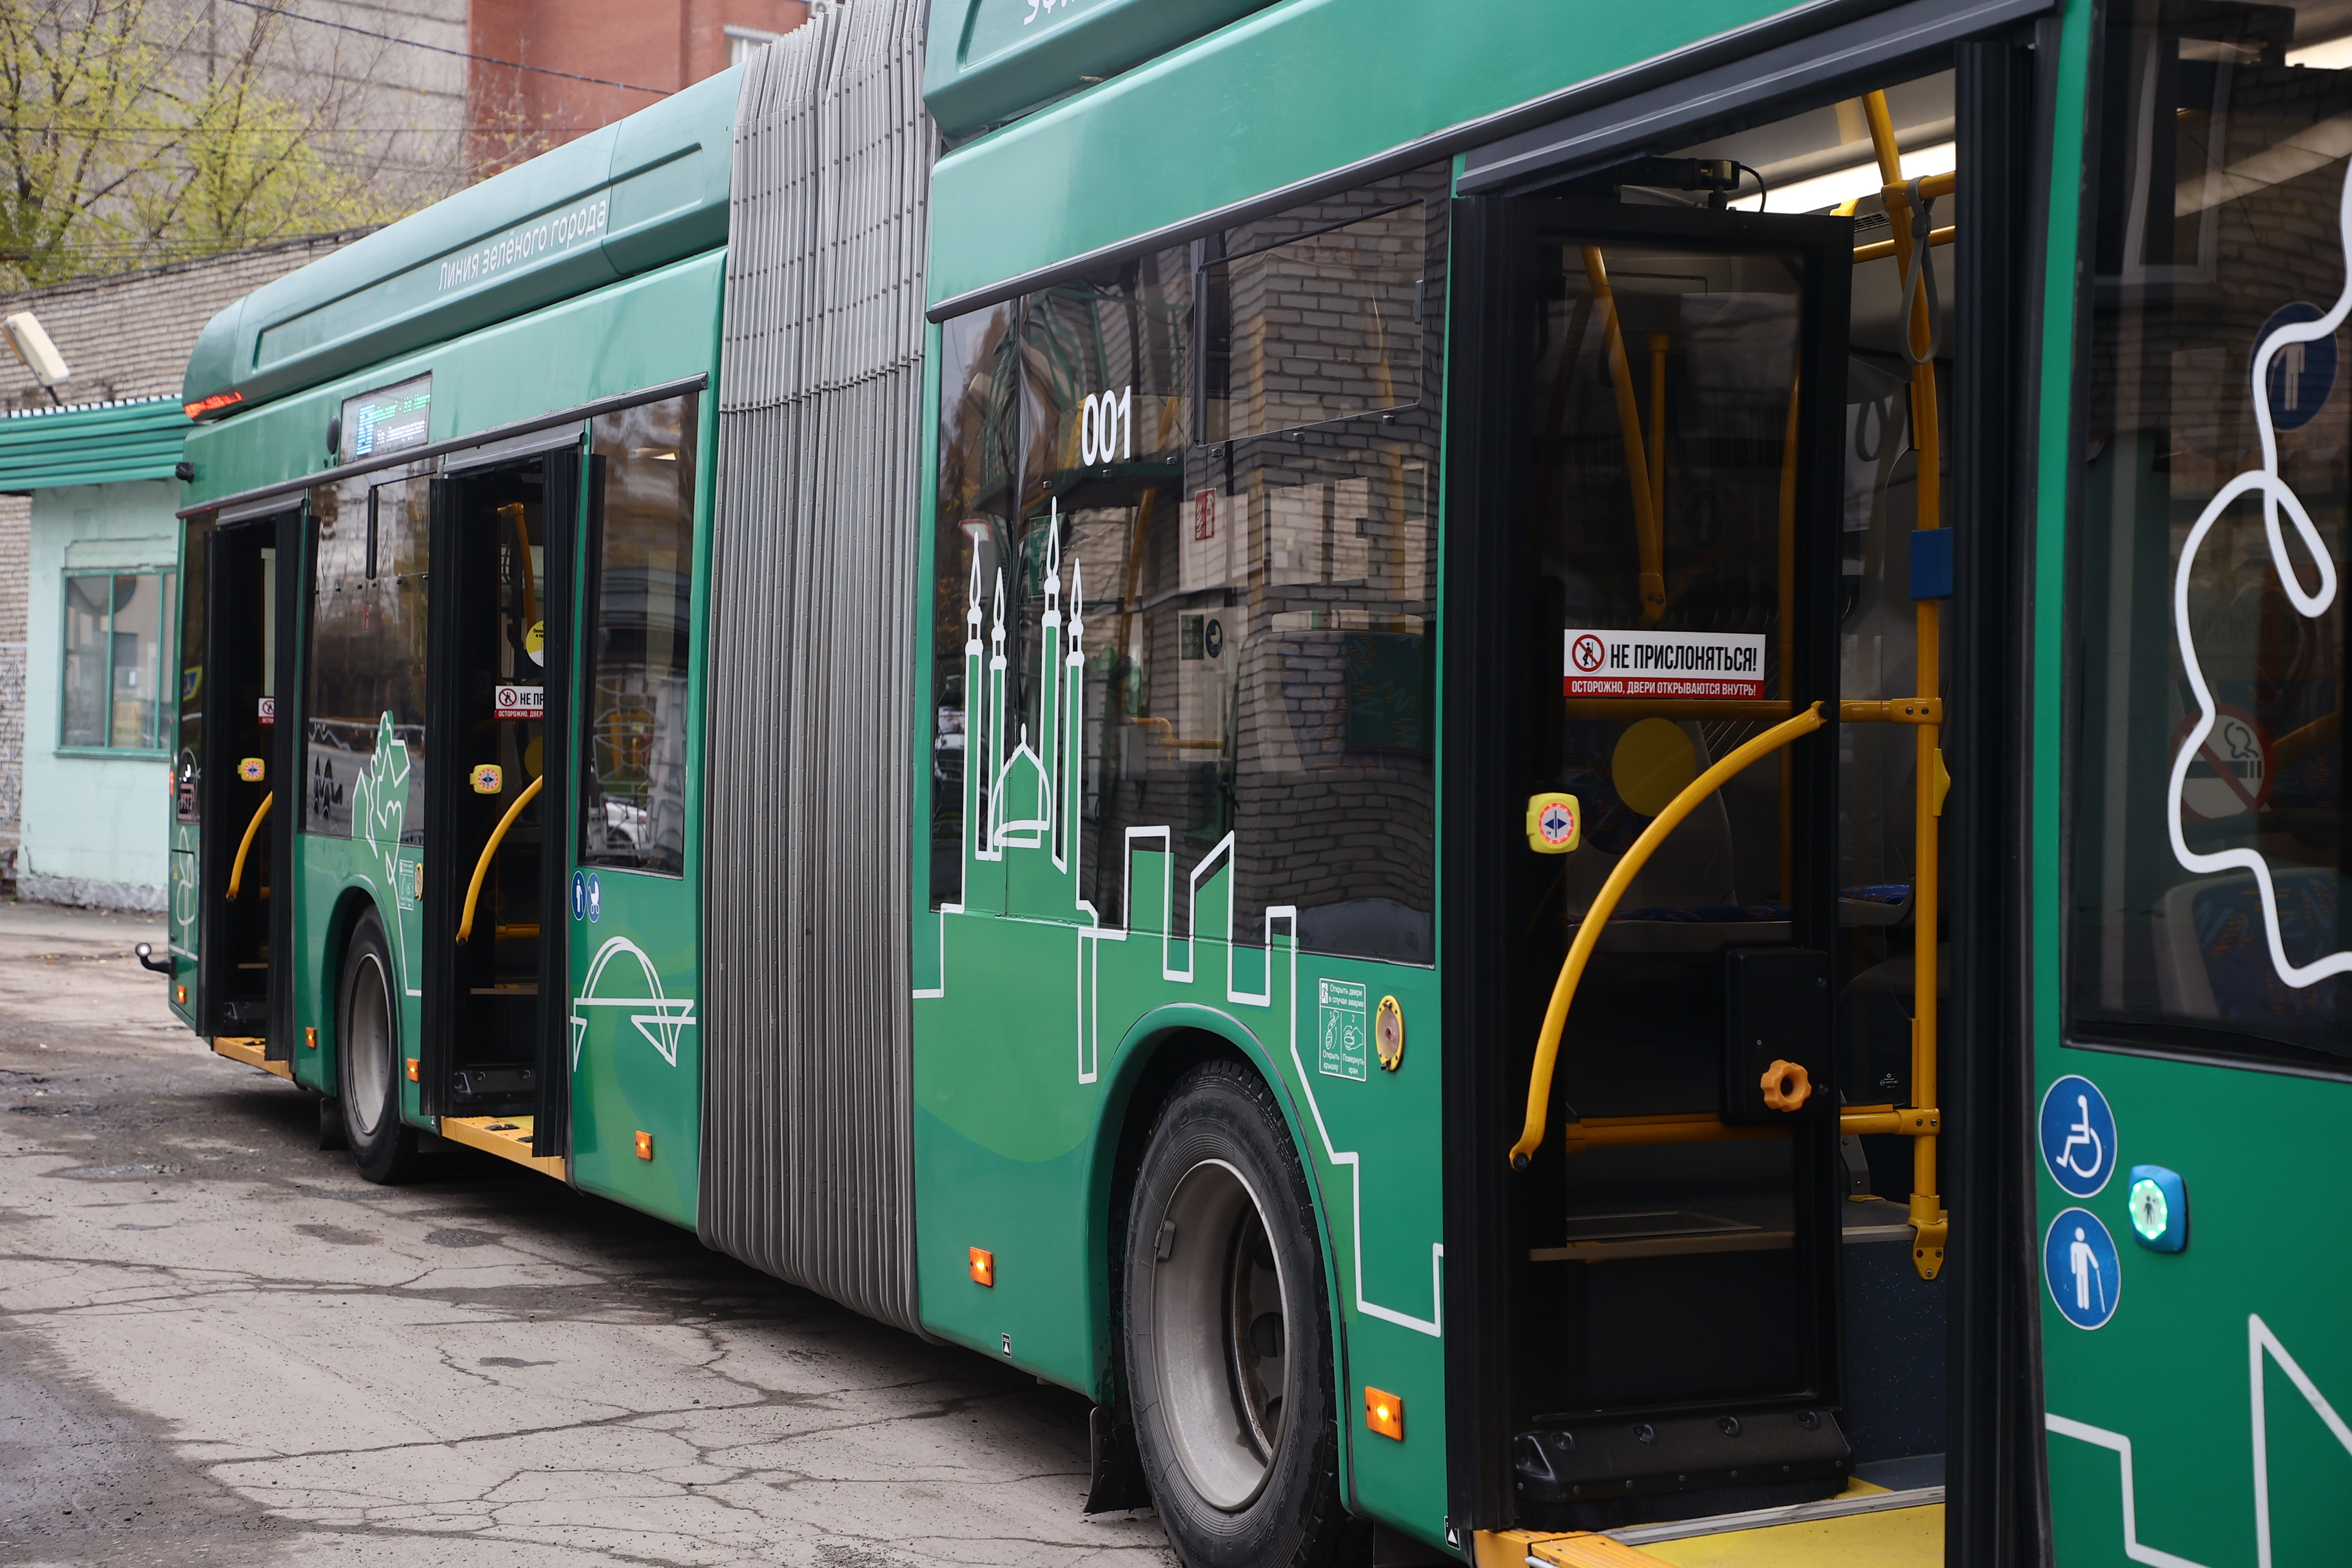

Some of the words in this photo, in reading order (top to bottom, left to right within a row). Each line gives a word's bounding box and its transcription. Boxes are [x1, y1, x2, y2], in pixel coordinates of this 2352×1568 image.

[438, 252, 480, 291] Линия
[482, 225, 547, 275] зелёного
[551, 199, 607, 249] города
[1081, 385, 1131, 466] 001
[1611, 643, 1630, 669] НЕ
[1634, 644, 1758, 672] ПРИСЛОНЯТЬСЯ!
[1571, 680, 1625, 694] ОСТОРОЖНО,
[1627, 681, 1656, 694] ДВЕРИ
[1657, 681, 1721, 695] ОТКРЫВАЮТСЯ
[1722, 683, 1757, 696] ВНУТРЬ!
[520, 692, 531, 705] НЕ
[534, 693, 544, 705] ПР
[1330, 984, 1349, 995] Открыть
[1349, 989, 1363, 998] двери
[1332, 997, 1348, 1006] случае
[1348, 999, 1364, 1008] аварии
[1351, 1014, 1355, 1023] 2
[1322, 1050, 1340, 1061] Открыть
[1342, 1054, 1364, 1066] Повернуть
[1323, 1063, 1339, 1073] крышку
[1348, 1067, 1358, 1075] кран
